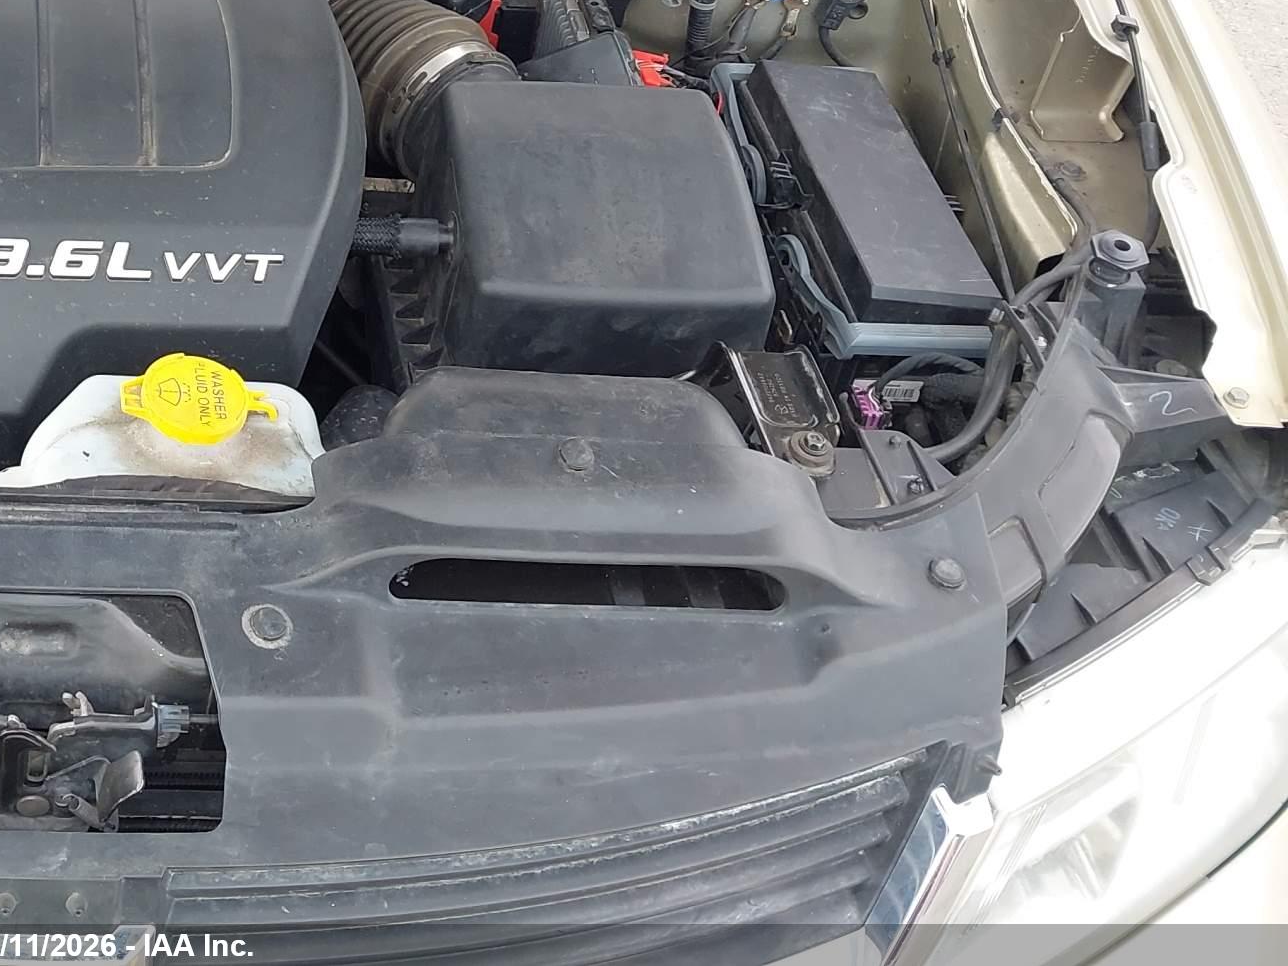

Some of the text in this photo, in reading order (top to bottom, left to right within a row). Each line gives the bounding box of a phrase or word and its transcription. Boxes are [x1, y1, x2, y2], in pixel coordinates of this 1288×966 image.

[164, 251, 285, 284] VVT
[194, 362, 212, 427] FLUID ONLY
[210, 370, 227, 421] WASHER
